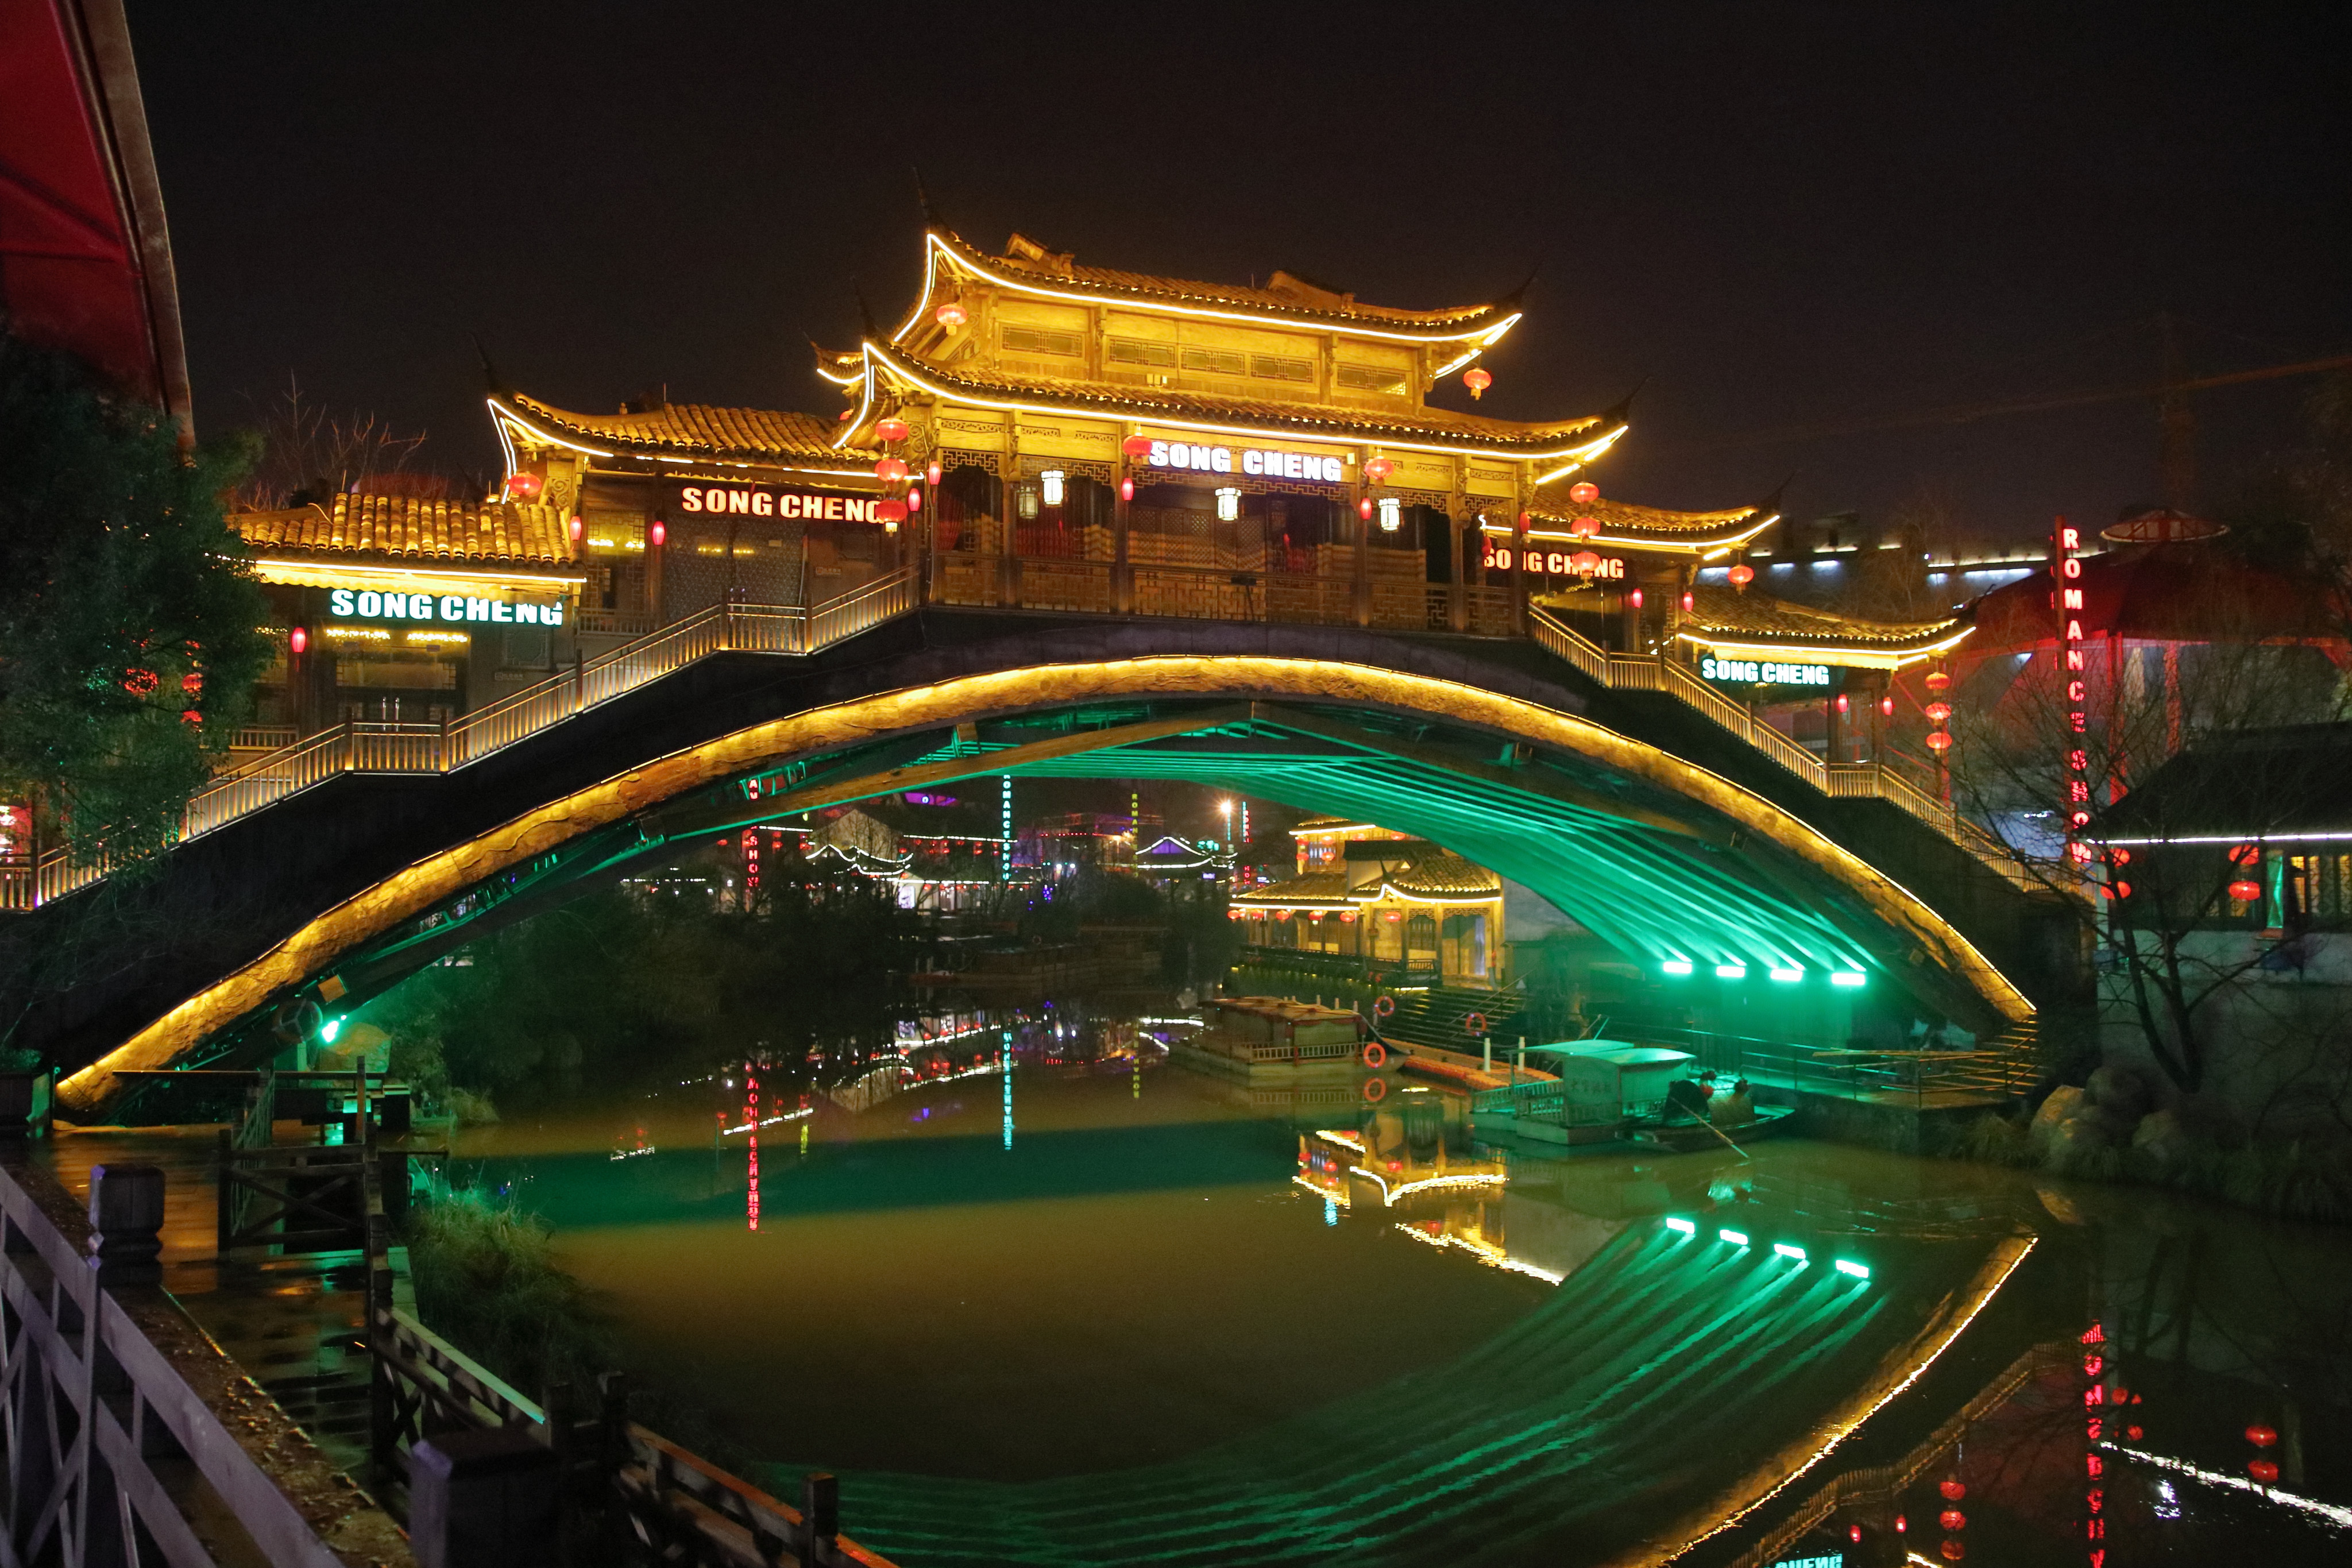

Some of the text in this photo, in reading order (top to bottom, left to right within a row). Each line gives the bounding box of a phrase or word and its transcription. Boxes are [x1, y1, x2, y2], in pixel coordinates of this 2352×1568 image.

[1149, 441, 1342, 482] SONG CHENG
[682, 487, 773, 516] SONG
[1484, 548, 1624, 579] SOG CHNG
[331, 589, 563, 626] SONG CHENG
[1702, 658, 1830, 686] SONG CHENG
[2061, 527, 2092, 864] ROMANCE SHOW
